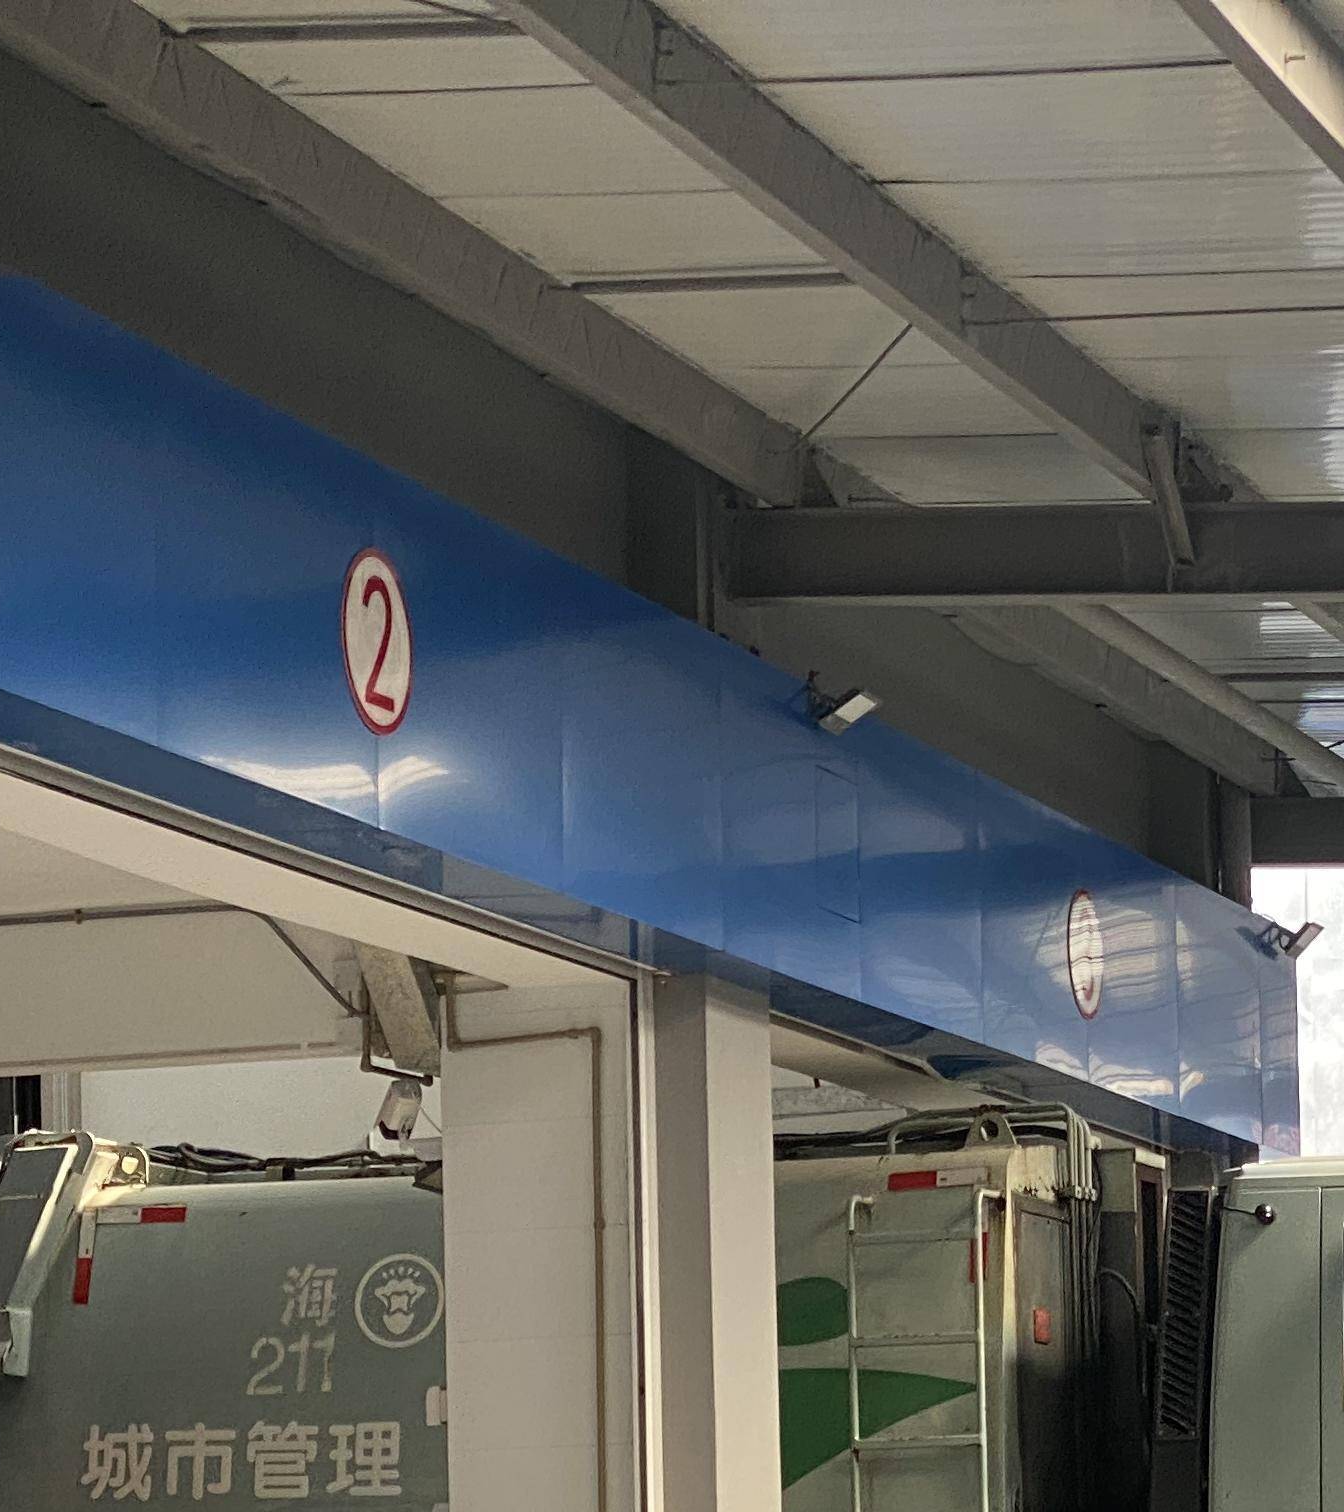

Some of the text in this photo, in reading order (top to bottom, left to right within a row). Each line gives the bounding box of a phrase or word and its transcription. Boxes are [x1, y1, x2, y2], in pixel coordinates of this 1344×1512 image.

[362, 575, 395, 712] 2
[280, 1264, 338, 1327] 海
[246, 1332, 337, 1396] 211
[81, 1421, 402, 1502] 城市管理
